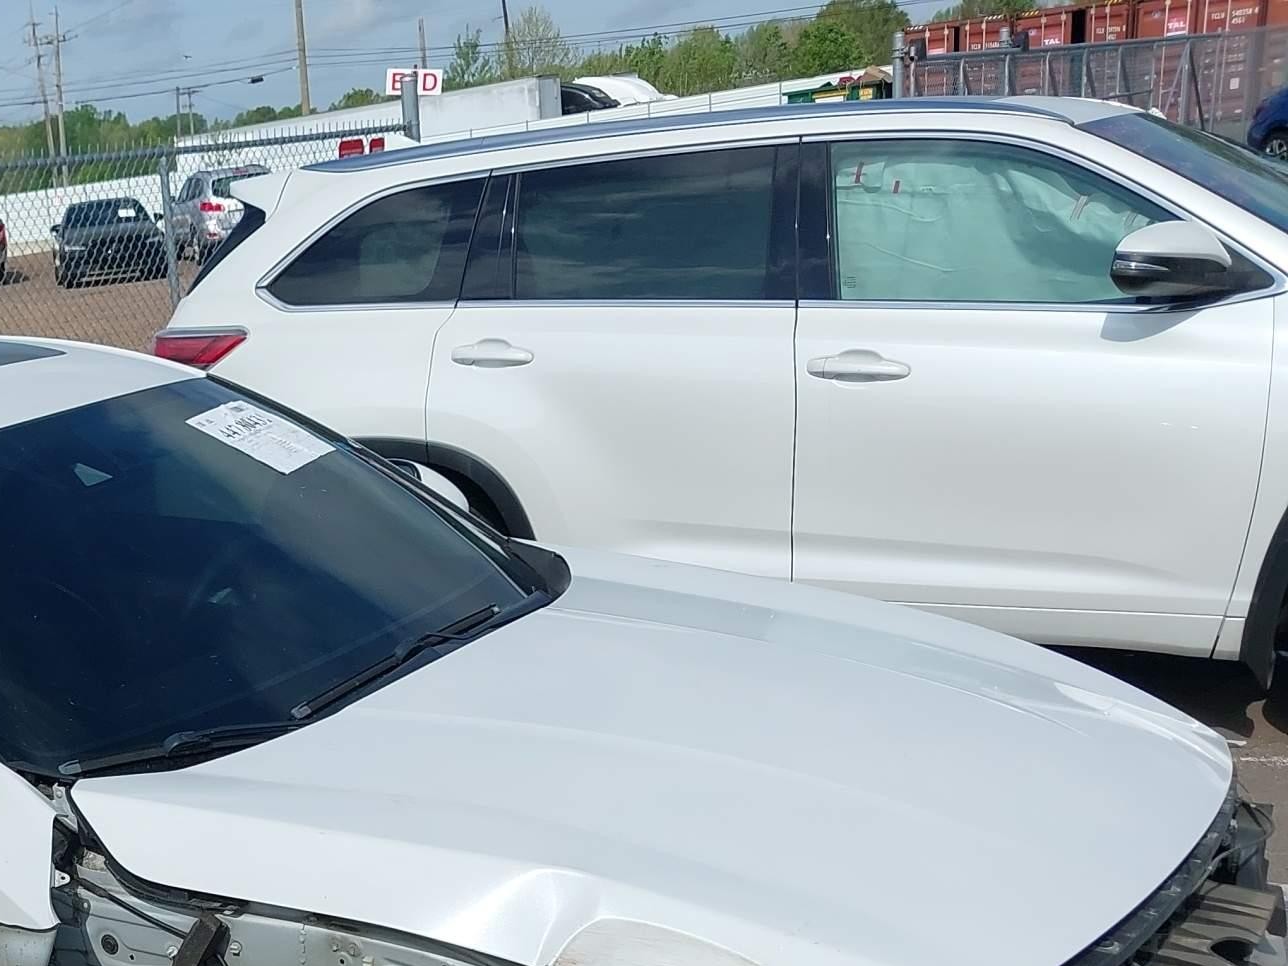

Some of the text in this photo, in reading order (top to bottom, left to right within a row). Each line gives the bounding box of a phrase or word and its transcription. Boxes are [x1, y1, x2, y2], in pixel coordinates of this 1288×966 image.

[1168, 21, 1186, 29] TAL
[1043, 38, 1061, 46] TAL
[392, 72, 437, 91] ED
